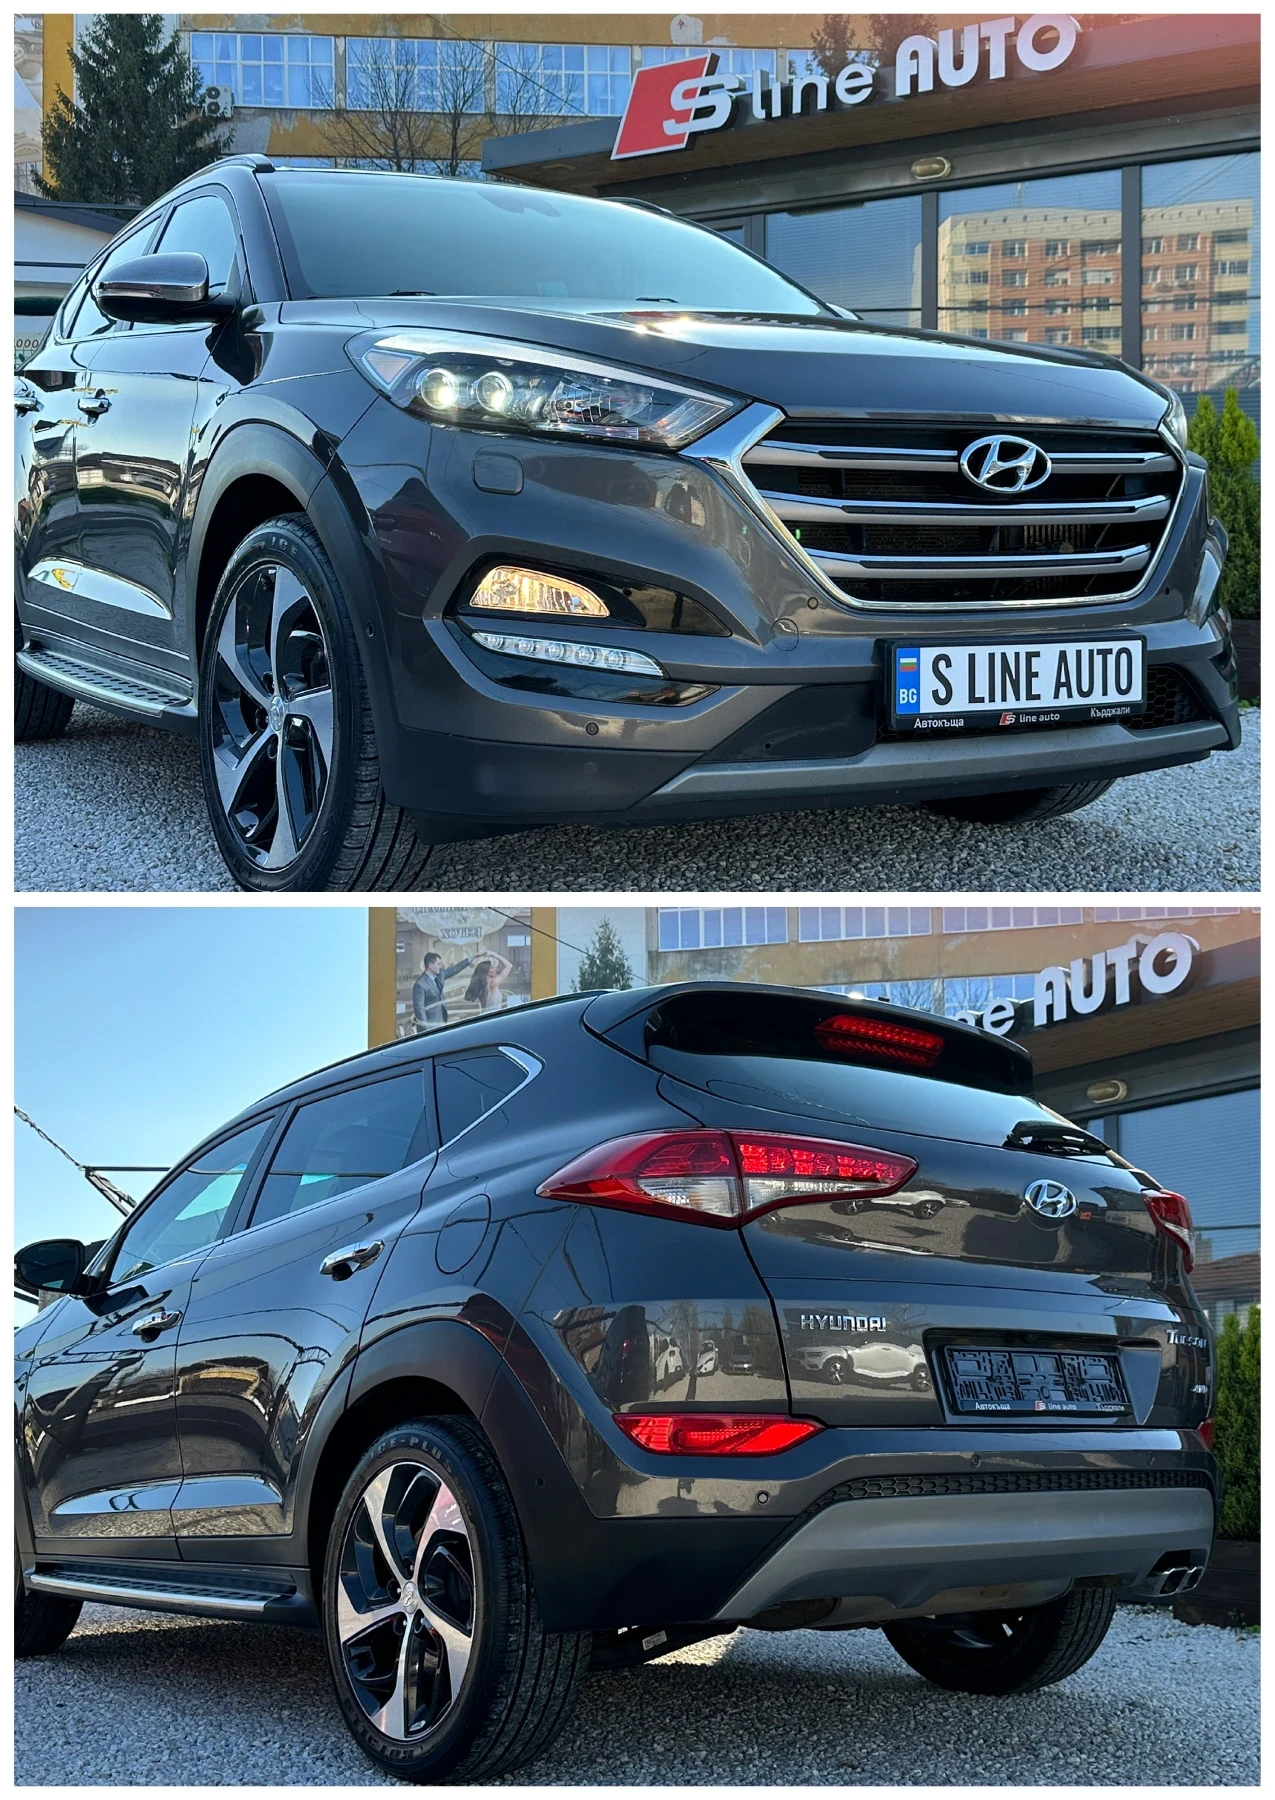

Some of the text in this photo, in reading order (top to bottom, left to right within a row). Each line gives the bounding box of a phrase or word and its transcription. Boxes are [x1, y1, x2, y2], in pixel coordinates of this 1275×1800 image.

[662, 14, 1080, 136] S line AUTO
[931, 647, 1133, 706] S LINE AUTO
[900, 688, 917, 704] BG
[1019, 713, 1037, 723] line
[1038, 712, 1060, 722] auto
[1090, 706, 1131, 718] Кърджали
[914, 717, 964, 729] Автокъща
[1034, 932, 1193, 1027] AUTO
[801, 1314, 886, 1332] HYUNDAI
[975, 1402, 1011, 1410] Автокъща
